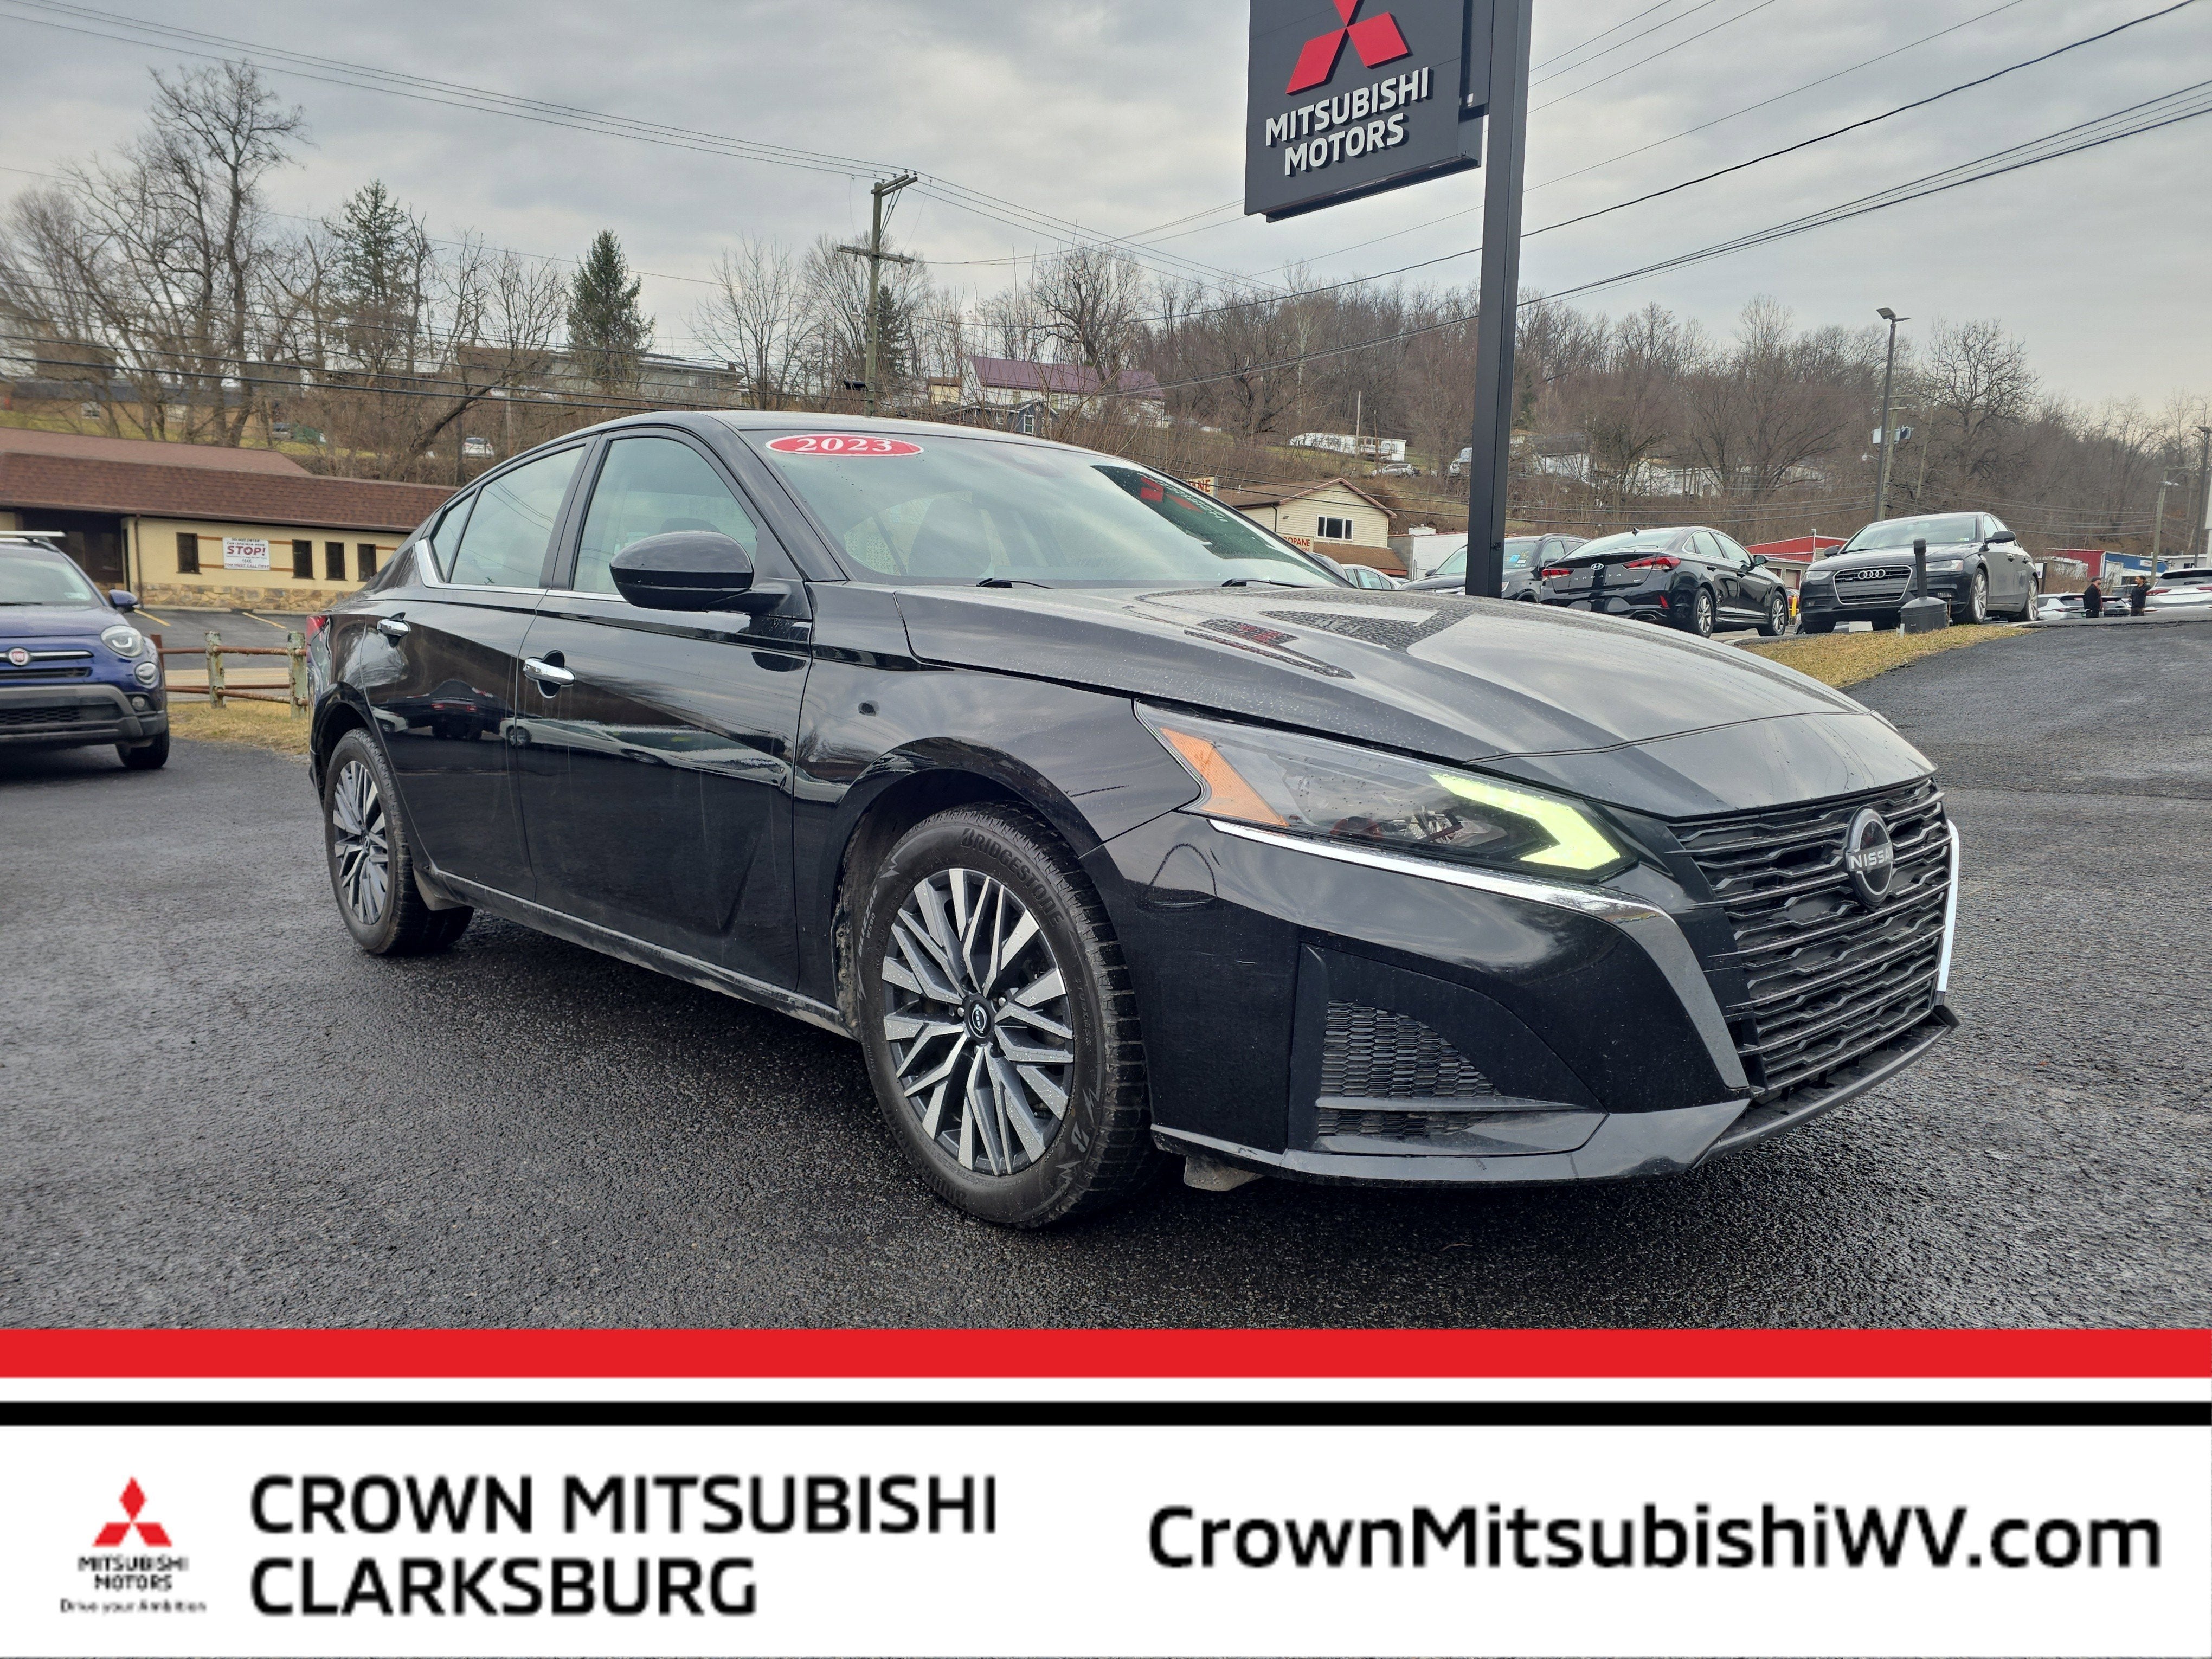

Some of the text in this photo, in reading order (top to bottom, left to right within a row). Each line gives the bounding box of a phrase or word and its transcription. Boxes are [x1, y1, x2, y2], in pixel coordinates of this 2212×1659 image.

[1265, 67, 1429, 147] MITSUBISHI
[1284, 113, 1404, 176] MOTORS
[795, 438, 892, 452] 2023
[227, 545, 266, 556] STOP!
[960, 828, 1064, 927] BRIDGESTONE
